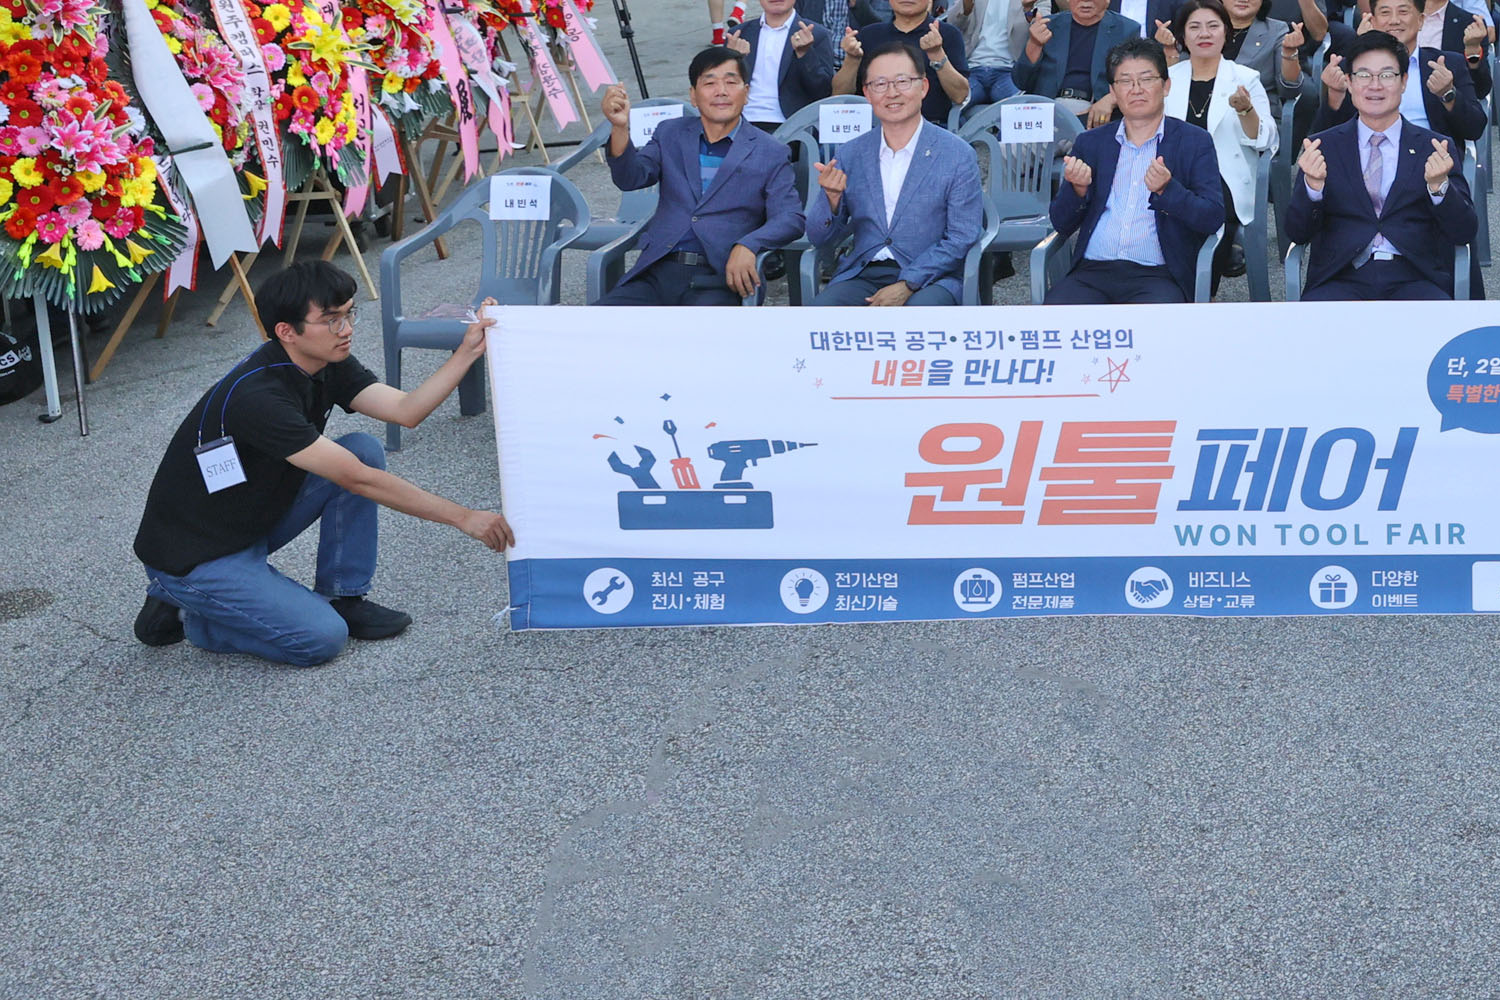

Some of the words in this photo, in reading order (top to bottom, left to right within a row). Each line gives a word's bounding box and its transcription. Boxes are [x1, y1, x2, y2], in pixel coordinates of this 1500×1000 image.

[831, 123, 865, 135] 내빈석
[1013, 120, 1045, 132] 내빈석
[504, 199, 538, 209] 내빈석
[809, 331, 898, 352] 대한민국
[1070, 328, 1135, 351] 산업의
[871, 359, 954, 387] 내일을
[964, 357, 1055, 386] 만나다!
[1446, 356, 1469, 379] 단,
[1446, 383, 1500, 404] 특별한
[206, 456, 237, 479] STAFF
[1174, 524, 1258, 546] WON
[1274, 523, 1369, 546] TOOL
[1386, 522, 1466, 545] FAIR
[651, 571, 683, 588] 최신
[692, 570, 726, 588] 공구
[834, 571, 899, 590] 전기산업
[1011, 571, 1076, 590] 펌프산업
[1188, 570, 1252, 588] 비즈니스
[1371, 569, 1419, 588] 다양한
[651, 593, 726, 611] 전시·체험
[834, 593, 899, 612] 최신기술
[1011, 593, 1076, 611] 전문제품
[1183, 593, 1256, 610] 상담·교류
[1371, 592, 1419, 609] 이벤트
